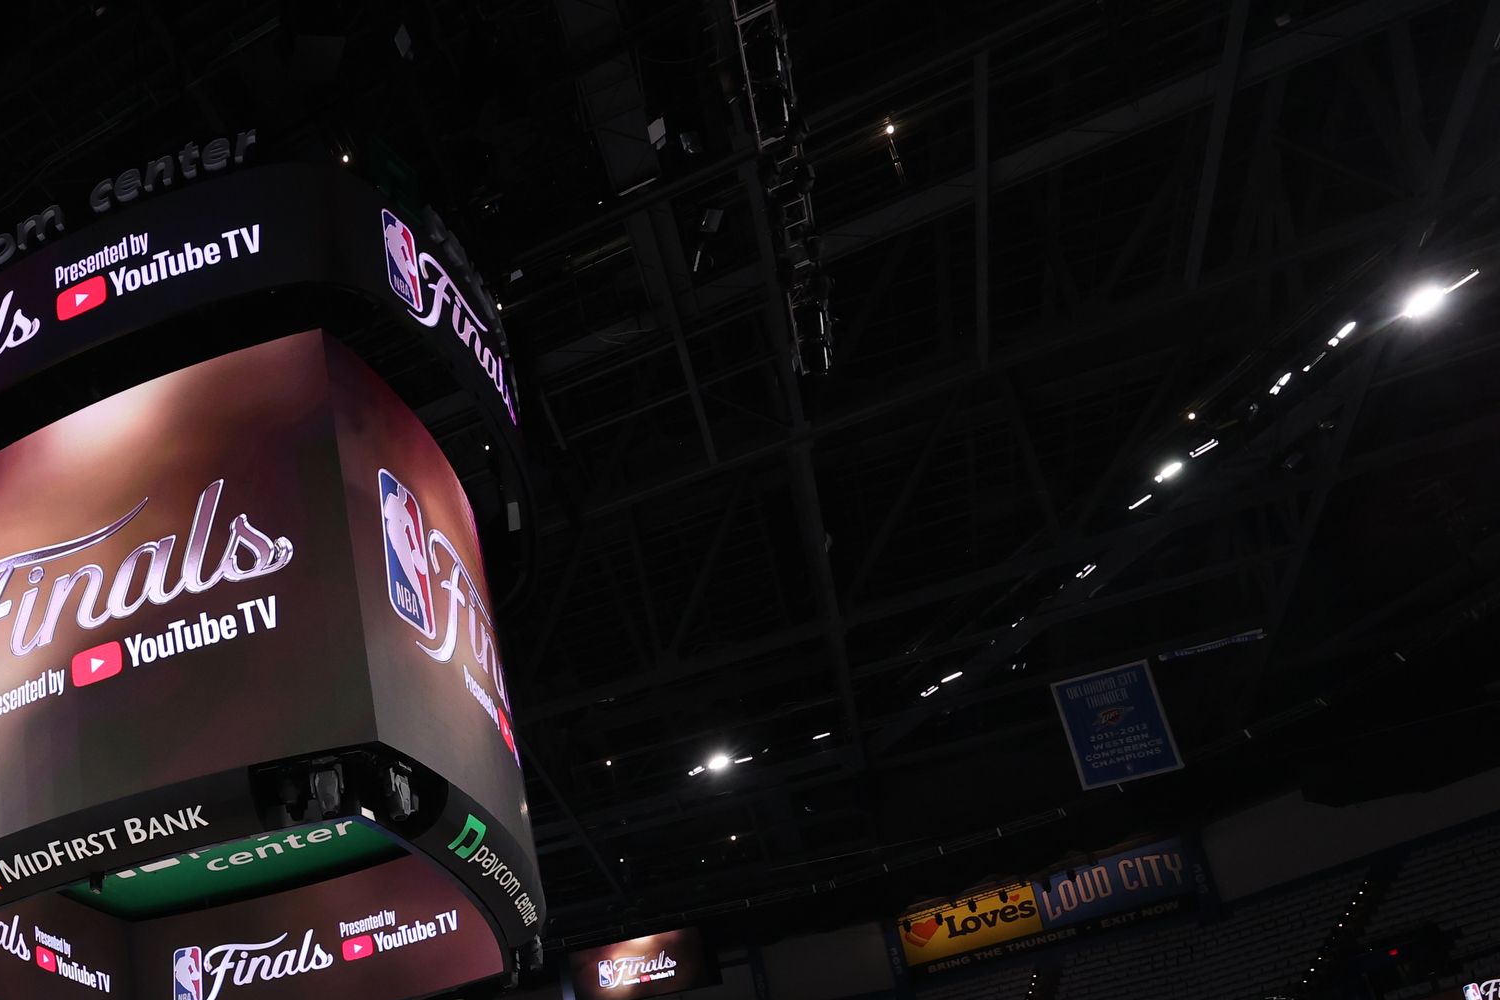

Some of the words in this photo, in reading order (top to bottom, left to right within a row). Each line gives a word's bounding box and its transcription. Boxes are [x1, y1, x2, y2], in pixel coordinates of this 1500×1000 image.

[90, 129, 257, 212] center
[55, 243, 127, 288] Presented
[127, 232, 149, 259] by
[109, 241, 221, 296] YouTube
[222, 224, 260, 259] TV
[393, 275, 411, 298] NBA
[395, 580, 419, 619] NBA
[124, 612, 237, 667] YouTube
[237, 595, 277, 634] TV
[47, 668, 65, 700] by
[206, 818, 353, 871] center
[469, 845, 521, 896] paycom
[515, 889, 538, 928] center
[1043, 864, 1112, 922] LOUD
[1117, 854, 1183, 891] CITY
[34, 925, 63, 954] Presented
[63, 937, 72, 958] by
[340, 914, 382, 937] Presented
[383, 909, 395, 926] by
[374, 923, 436, 953] YouTube
[436, 910, 457, 936] TV
[928, 956, 971, 974] BRING
[974, 946, 1003, 961] THE
[1006, 928, 1076, 952] THUNDER
[1101, 914, 1137, 929] EXIT
[1141, 901, 1179, 916] NOW
[56, 954, 97, 989] YouTube
[96, 971, 110, 993] TV
[610, 950, 677, 988] Finals
